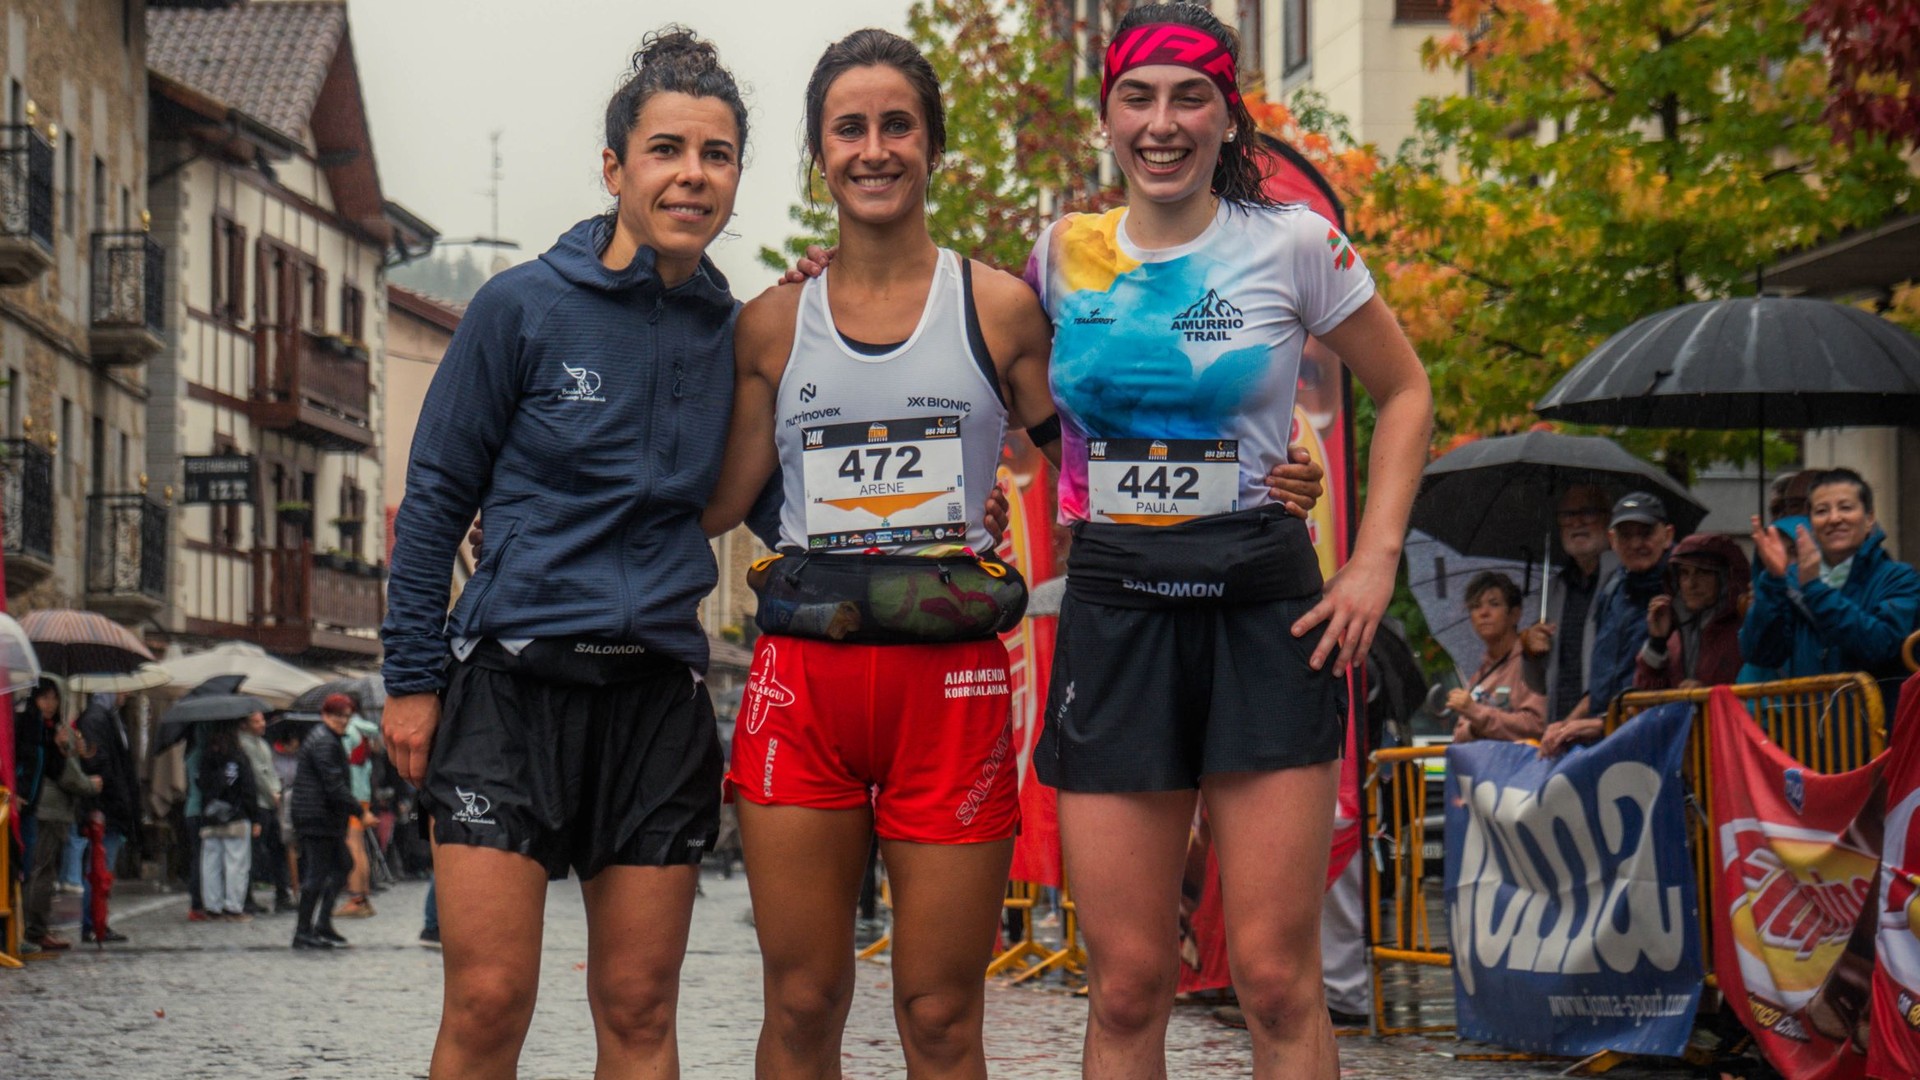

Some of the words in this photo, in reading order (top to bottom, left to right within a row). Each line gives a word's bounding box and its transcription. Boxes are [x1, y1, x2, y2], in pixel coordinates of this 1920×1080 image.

[1171, 319, 1244, 331] AMURRIO
[1184, 331, 1231, 342] TRAIL
[927, 397, 971, 412] BIONIC
[785, 407, 841, 428] nutrinovex
[806, 430, 824, 446] 14K
[1091, 441, 1107, 457] 14K
[838, 446, 923, 483] 472
[859, 482, 905, 496] ARENE
[1117, 465, 1199, 500] 442
[1136, 502, 1178, 514] PAULA
[1121, 579, 1226, 598] SALOMON
[574, 642, 646, 655] SALOMON
